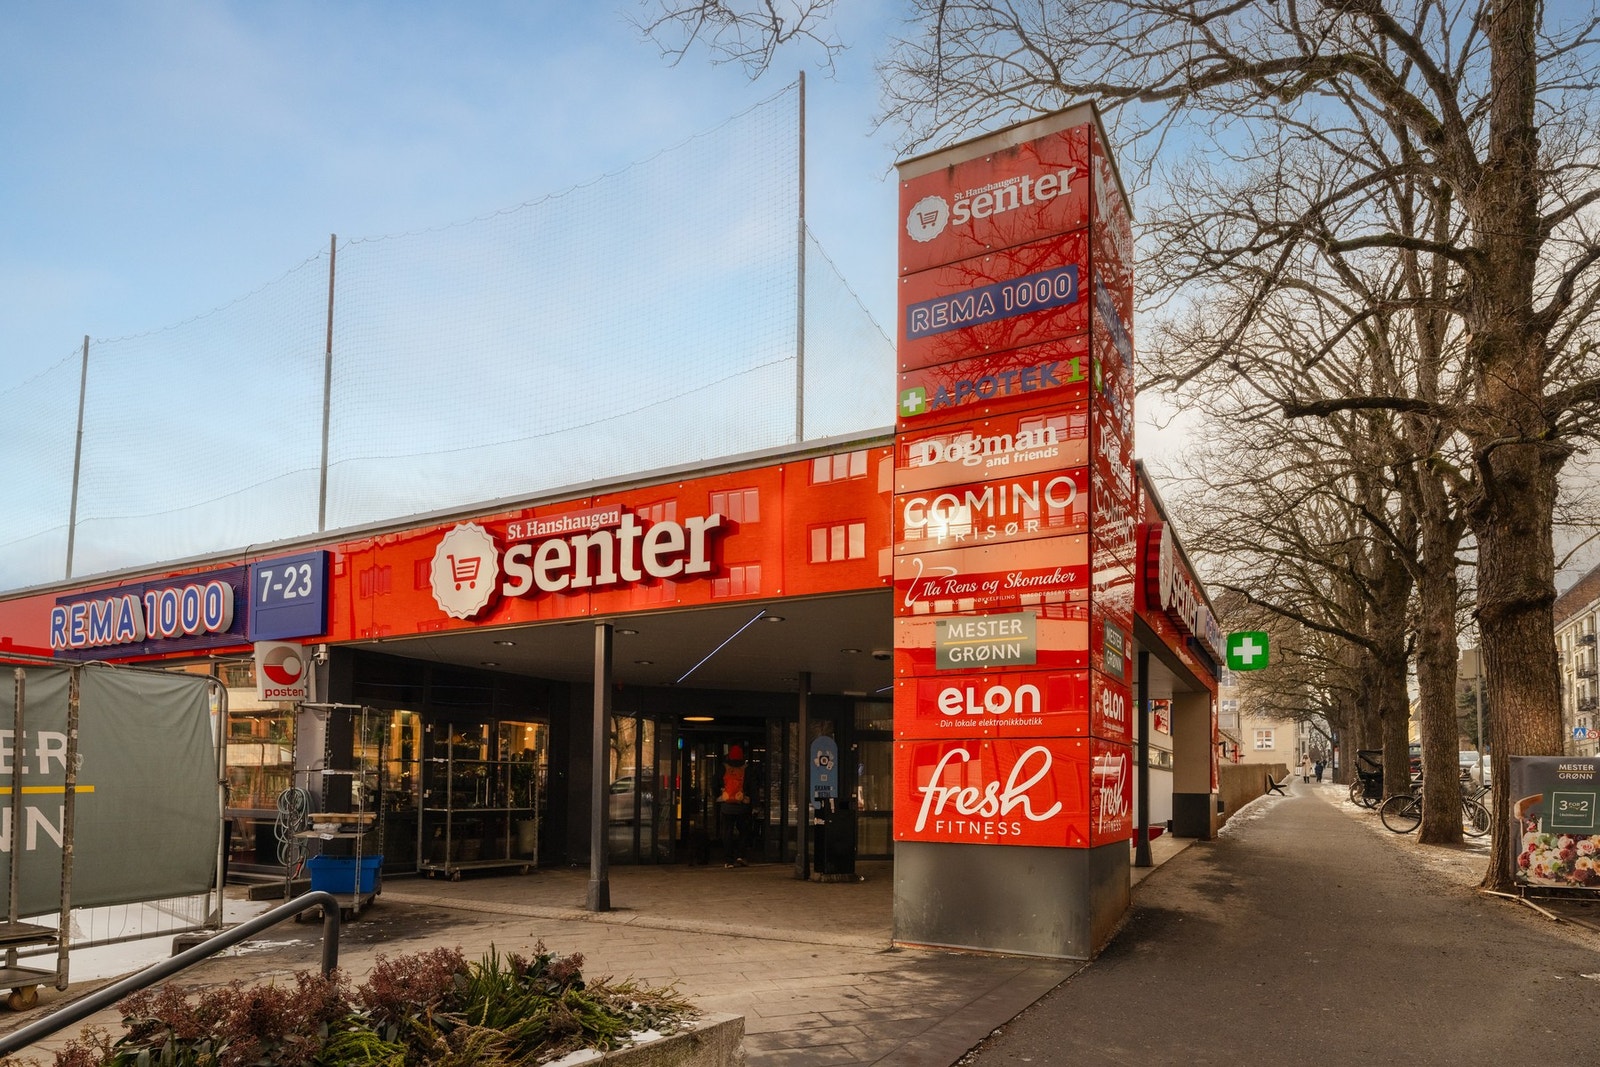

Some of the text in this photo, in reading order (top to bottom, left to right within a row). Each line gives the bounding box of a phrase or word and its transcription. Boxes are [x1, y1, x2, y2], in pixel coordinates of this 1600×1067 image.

[952, 167, 1077, 226] senter
[954, 175, 1020, 201] St. Hanshaugen
[911, 273, 1072, 333] REMA 1000
[931, 357, 1084, 410] APOTEK 1
[918, 426, 1059, 467] Dogman
[986, 447, 1059, 468] and friends
[903, 476, 1077, 528] COMINO
[508, 510, 619, 540] St. Hanshaugen
[937, 519, 1039, 544] FRISØR
[502, 512, 721, 597] senter
[260, 563, 312, 602] 7-23
[945, 577, 978, 595] Rens
[982, 577, 999, 593] og
[1004, 567, 1077, 589] Skomaker
[50, 580, 230, 650] REMA 1000
[948, 619, 1023, 639] MESTER
[949, 643, 1021, 662] GRØNN
[264, 686, 304, 699] posten
[940, 719, 953, 728] Din
[955, 718, 977, 728] lokale
[978, 717, 1043, 727] elektronikkbutikk
[1558, 763, 1594, 771] MESTER
[1558, 772, 1593, 780] GRØNN
[914, 745, 1062, 833] fresh
[1099, 752, 1128, 834] fresh
[1559, 800, 1568, 811] 3
[1580, 800, 1588, 811] 2
[936, 820, 1021, 836] FITNESS
